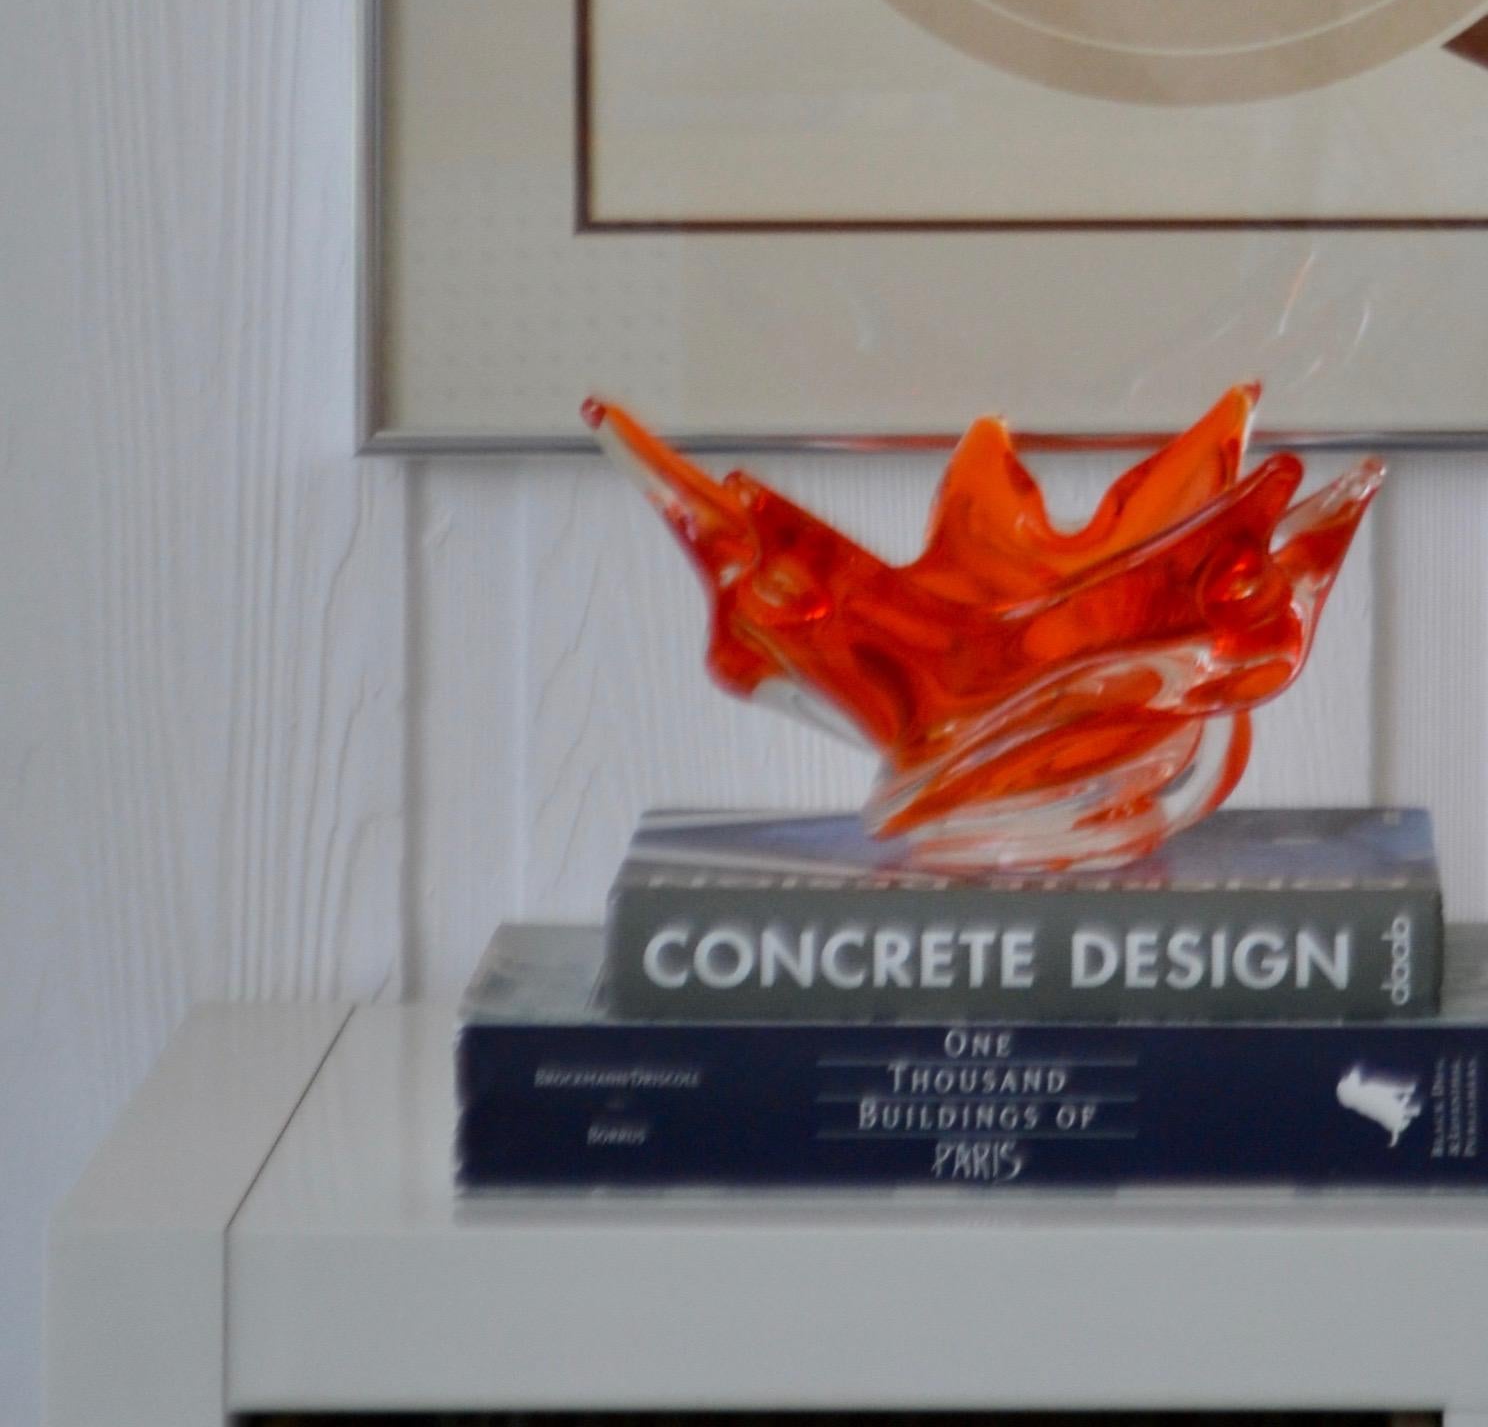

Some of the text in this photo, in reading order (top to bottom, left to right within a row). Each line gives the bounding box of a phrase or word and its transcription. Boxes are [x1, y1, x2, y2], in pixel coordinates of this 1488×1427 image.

[642, 928, 1351, 990] CONCRETE DESIGN
[944, 1029, 1013, 1058] ONE
[887, 1059, 1068, 1094] THOUSAND
[858, 1097, 1098, 1131] BUILDINGS OF
[931, 1140, 1023, 1181] PARIS
